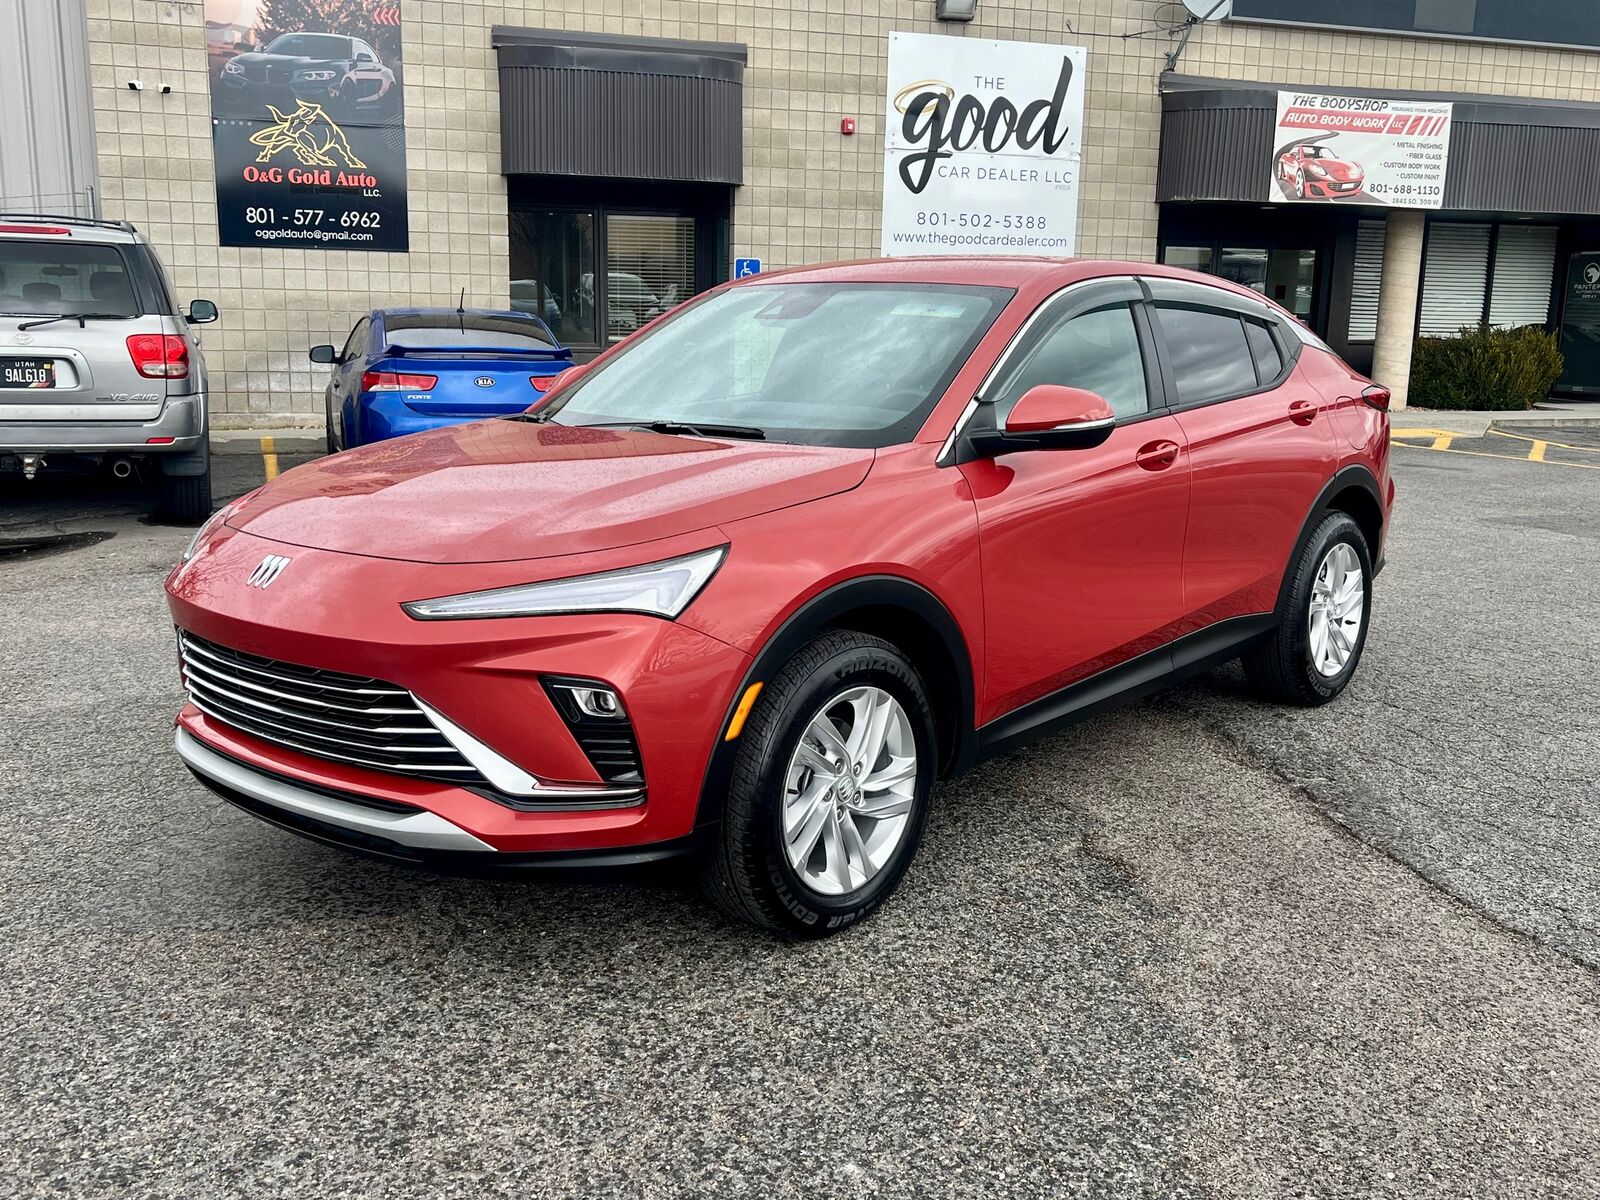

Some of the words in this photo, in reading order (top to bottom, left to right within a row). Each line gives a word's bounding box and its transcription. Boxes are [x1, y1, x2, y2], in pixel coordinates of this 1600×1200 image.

[974, 75, 1006, 90] THE
[1291, 95, 1316, 107] THE
[1320, 96, 1389, 112] BODYSHOP
[899, 55, 1074, 195] good
[1286, 112, 1317, 124] AUTO
[1320, 115, 1352, 126] BODY
[1349, 118, 1387, 129] WORK
[1391, 121, 1404, 129] LLC
[1416, 142, 1443, 150] FINISHING
[937, 165, 970, 179] CAR
[977, 167, 1039, 182] DEALER
[1045, 171, 1073, 184] LLC
[1424, 163, 1441, 171] WORK
[243, 166, 283, 184] O&G
[288, 168, 331, 186] Gold
[336, 171, 377, 188] Auto
[1424, 173, 1439, 181] PAINT
[363, 189, 382, 197] LLC.
[1369, 183, 1440, 196] 801-688-1130
[246, 207, 275, 225] 801
[293, 209, 324, 226] 577
[340, 211, 381, 228] 6962
[916, 212, 1048, 230] 801-502-5388
[255, 228, 373, 241] oggoldauto@gmail.com
[893, 231, 1068, 248] www.thegoodcardealer.com
[5, 368, 47, 383] 9AL618
[130, 393, 160, 401] 4WD
